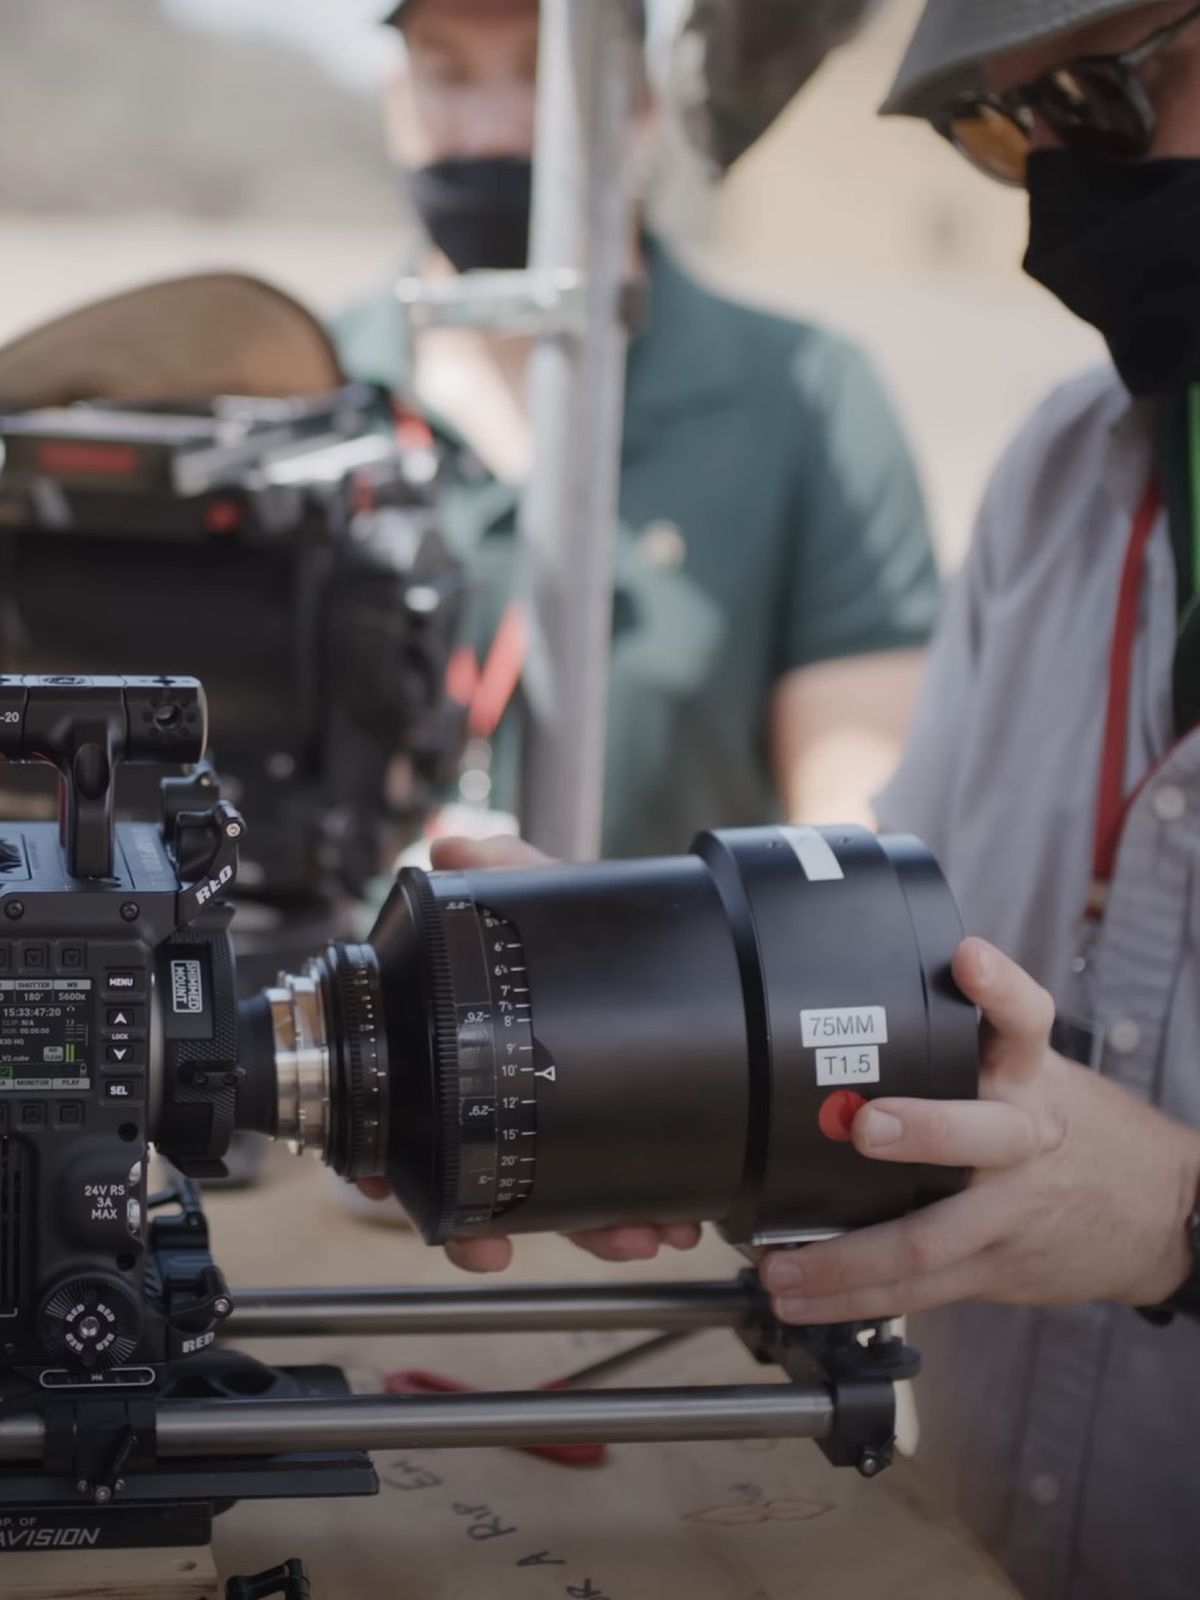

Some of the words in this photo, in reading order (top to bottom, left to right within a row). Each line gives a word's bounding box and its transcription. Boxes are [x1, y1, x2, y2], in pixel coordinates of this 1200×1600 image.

[109, 978, 133, 987] MENU
[174, 966, 188, 1004] MOUNT
[185, 961, 200, 1010] SHIMMED
[3, 1008, 62, 1018] 15:33:47:20
[809, 1015, 875, 1037] 75MM
[824, 1054, 870, 1075] T1.5
[110, 1085, 128, 1096] SEL
[84, 1185, 107, 1196] 24V
[110, 1185, 126, 1196] RS
[96, 1197, 113, 1208] 3A
[91, 1209, 118, 1219] MAX
[65, 1303, 86, 1323] RED
[96, 1303, 116, 1323] RED
[64, 1332, 84, 1352] RED
[95, 1332, 116, 1352] RED
[19, 1517, 38, 1527] OF
